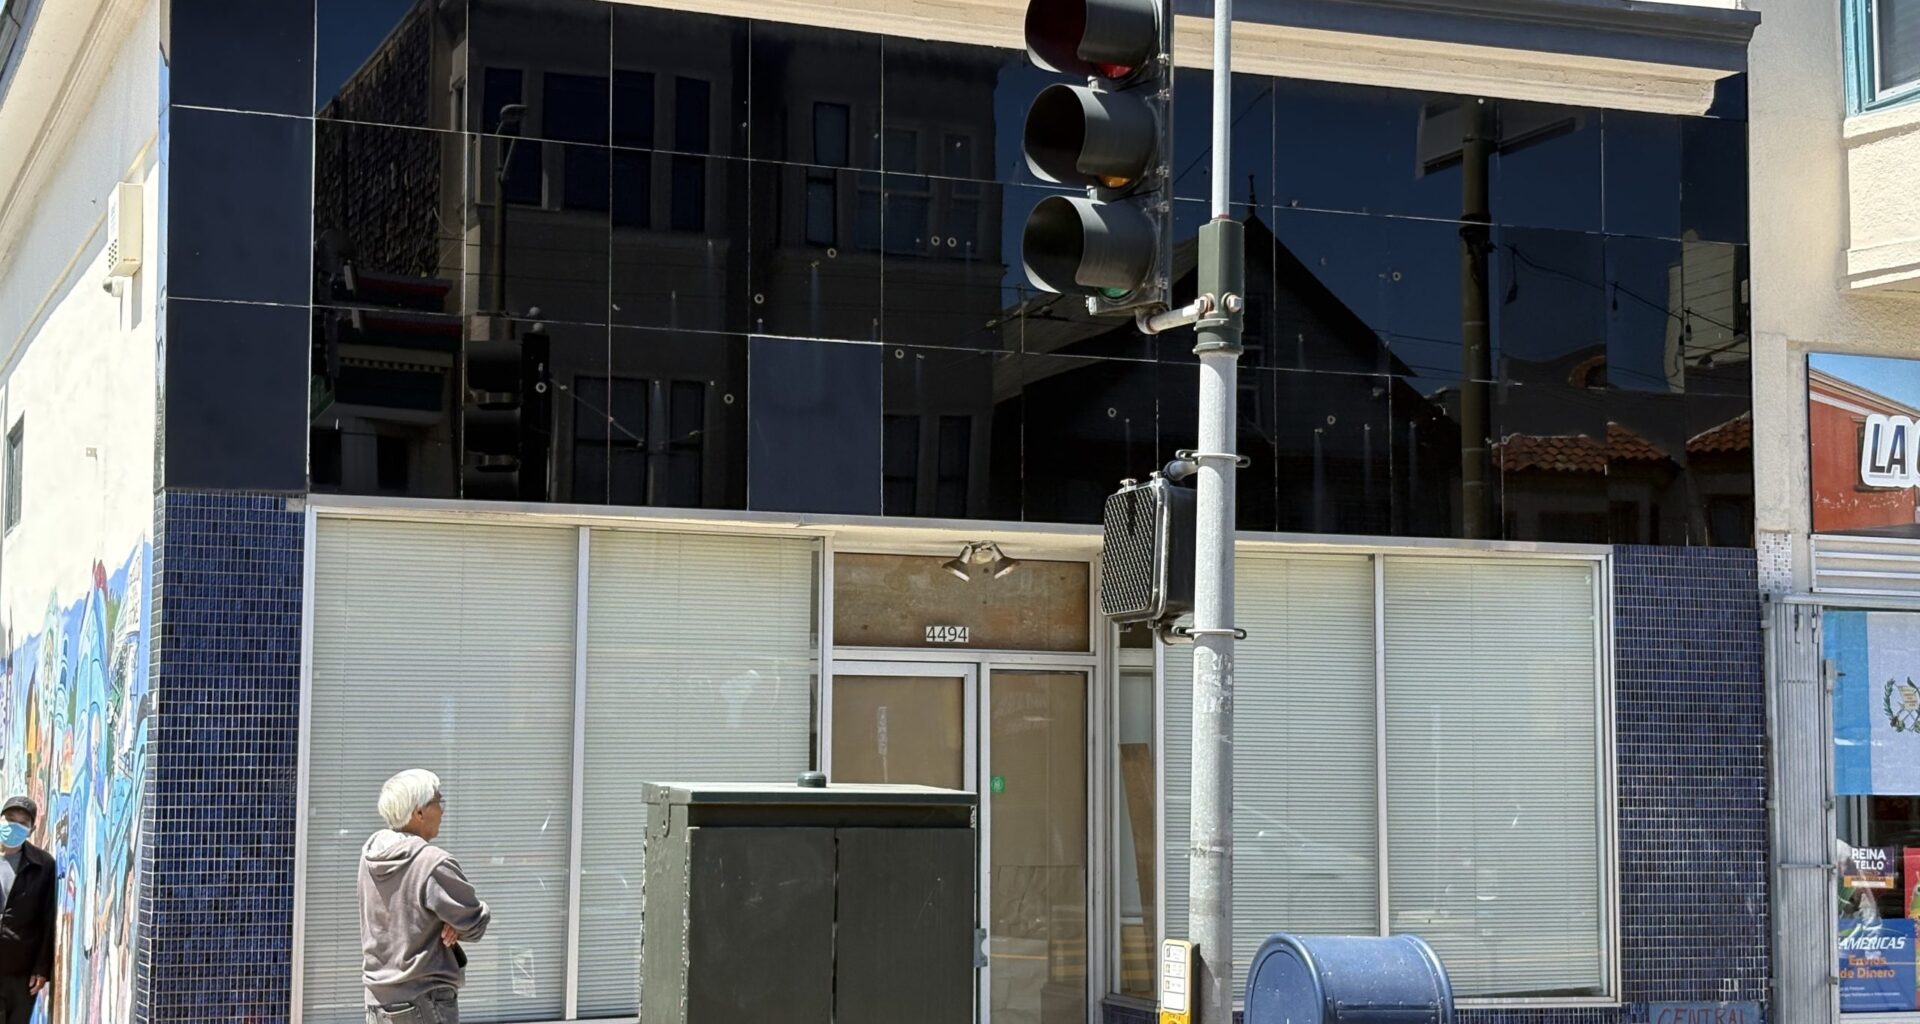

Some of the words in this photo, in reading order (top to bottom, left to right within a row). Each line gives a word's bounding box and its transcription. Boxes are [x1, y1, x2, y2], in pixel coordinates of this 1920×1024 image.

[1869, 423, 1906, 475] LA
[926, 626, 968, 642] 4494
[1852, 848, 1886, 860] REINA
[1854, 860, 1884, 870] TELLO
[1839, 937, 1906, 950] AMERICAS
[1857, 967, 1895, 978] Dinero
